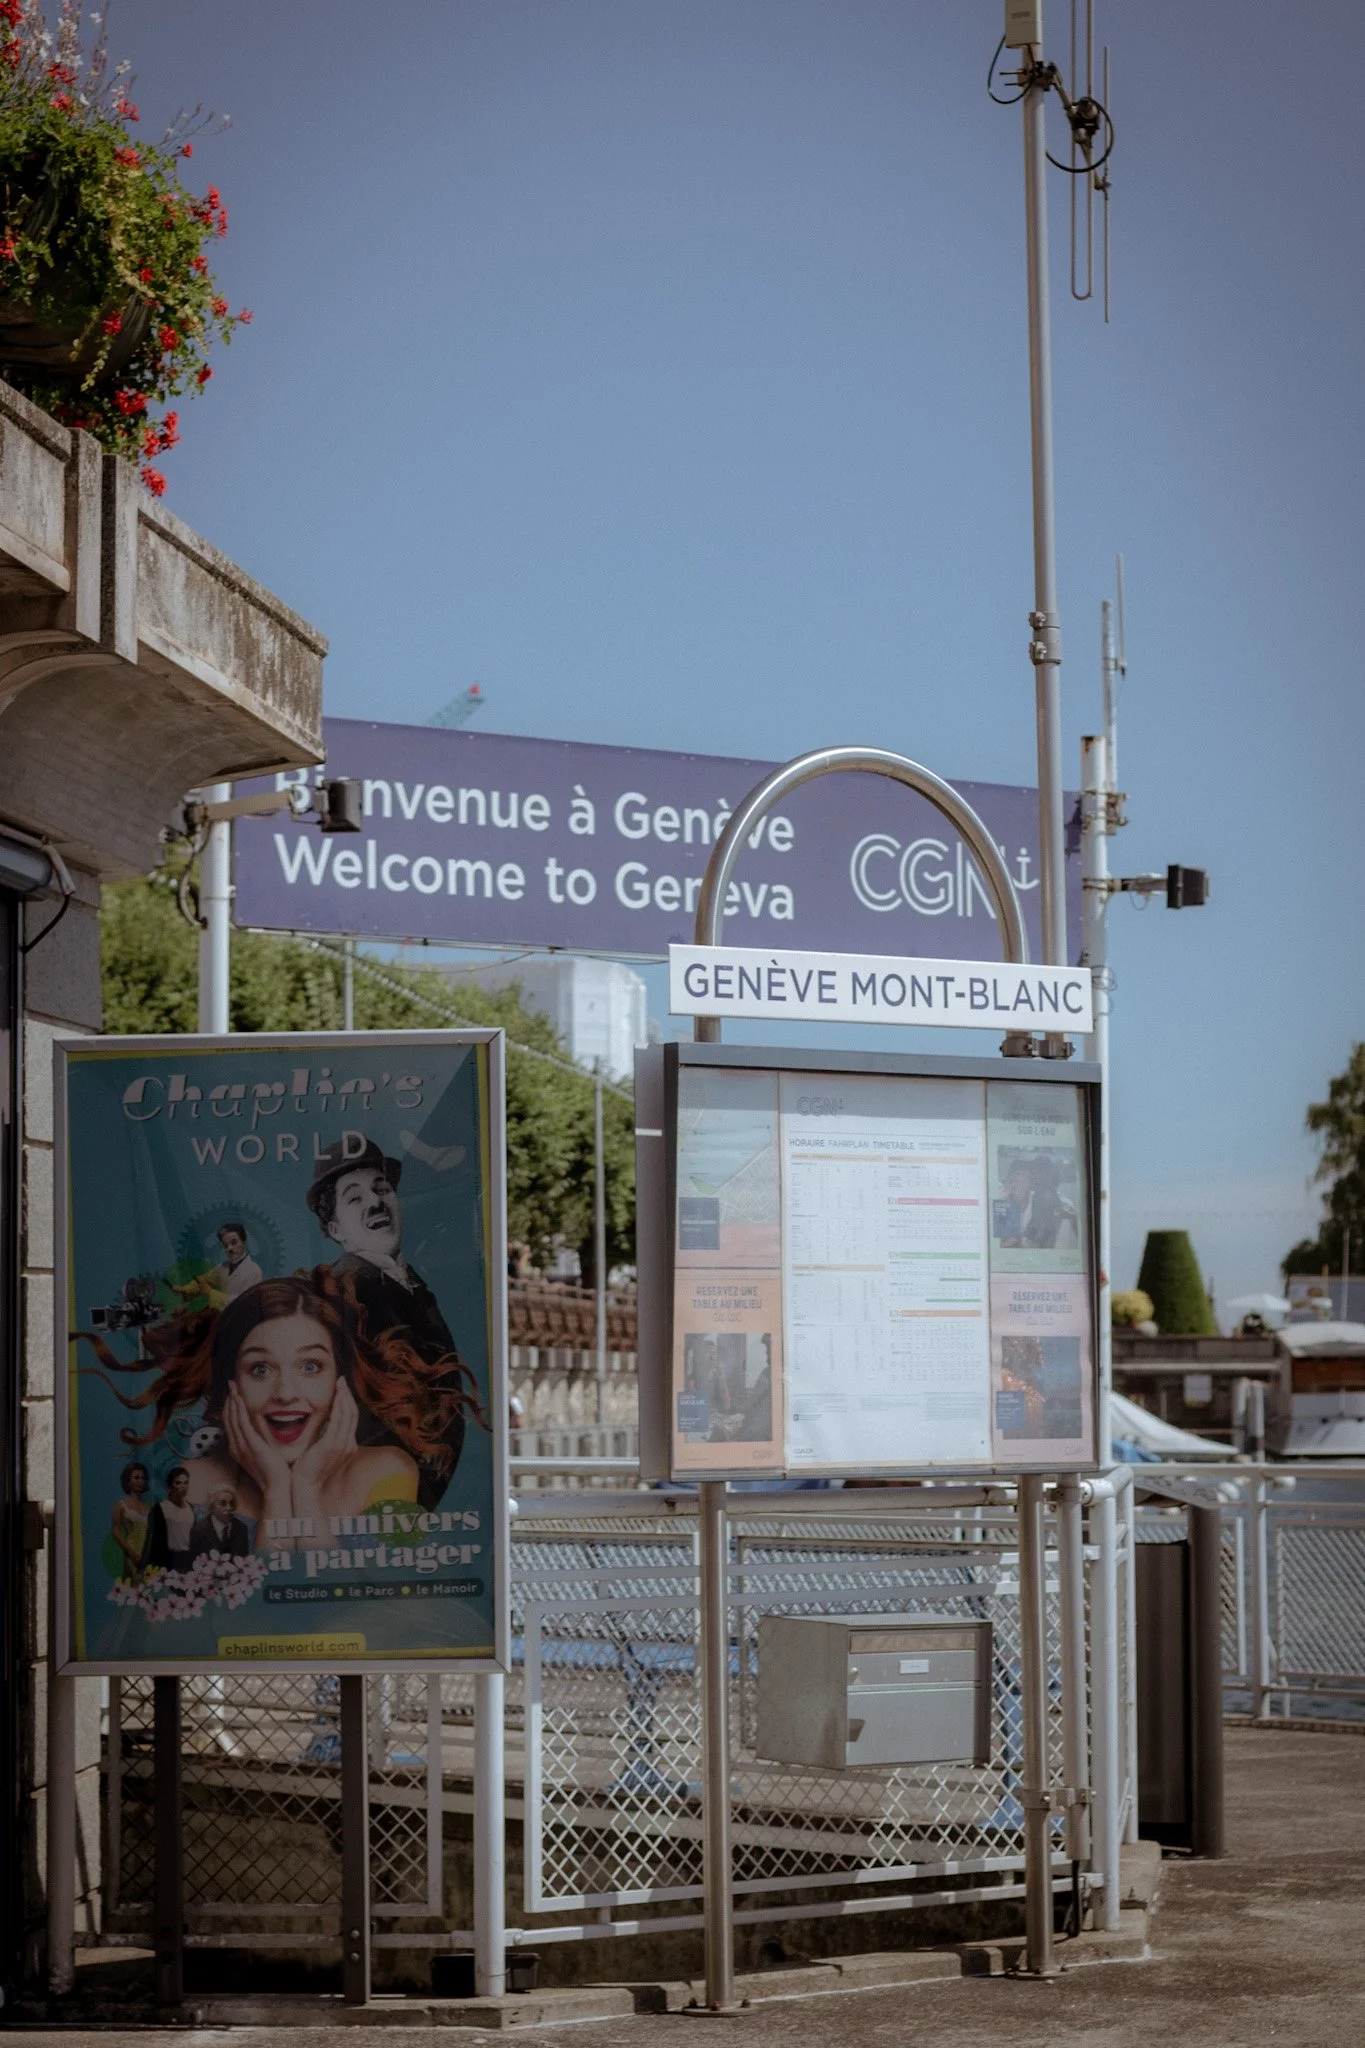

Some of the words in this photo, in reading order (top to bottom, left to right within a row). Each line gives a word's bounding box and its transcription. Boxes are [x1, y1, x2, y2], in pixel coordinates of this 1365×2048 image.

[274, 764, 550, 831] Bnvenue
[567, 783, 597, 837] à
[273, 833, 526, 901] Welcome
[544, 857, 598, 906] to
[684, 958, 838, 1004] GENÈVE
[851, 970, 1085, 1015] MONT-BLANC
[121, 1066, 424, 1130] Chaplin's
[190, 1129, 369, 1168] WORLD
[789, 1137, 825, 1148] HORAIRE
[828, 1138, 869, 1149] FAHRPLAN
[872, 1140, 915, 1151] TIMETABLE
[263, 1515, 316, 1539] un
[329, 1505, 481, 1538] univers
[267, 1540, 293, 1572] à
[305, 1542, 482, 1579] partager
[269, 1588, 282, 1600] le
[285, 1587, 329, 1600] Studio
[349, 1586, 361, 1598] le
[366, 1585, 396, 1598] Parc
[416, 1583, 429, 1596] le
[433, 1581, 478, 1595] Manoir
[224, 1639, 360, 1656] chaplinsworld.com
